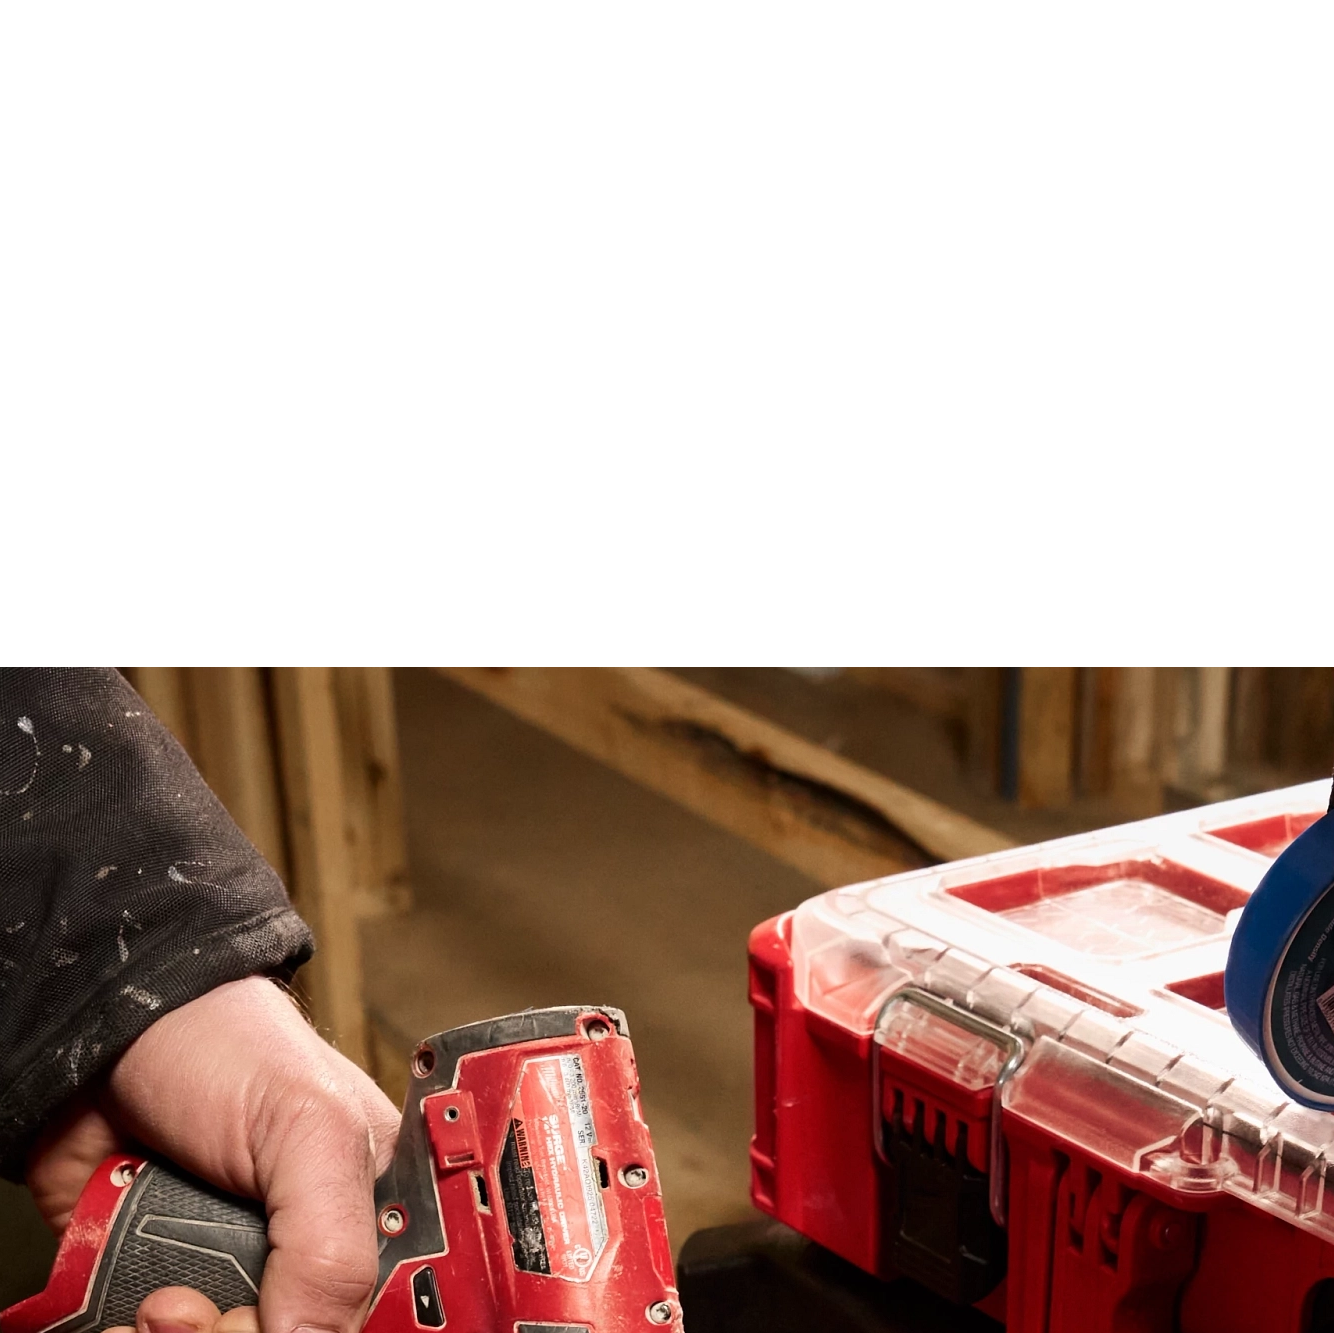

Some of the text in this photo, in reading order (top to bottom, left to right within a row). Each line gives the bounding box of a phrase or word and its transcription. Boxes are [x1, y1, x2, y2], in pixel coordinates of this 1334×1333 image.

[1306, 932, 1327, 962] Density
[543, 1136, 554, 1156] HEX
[547, 1156, 564, 1210] HYDRAULIC
[557, 1210, 571, 1245] DRIVER
